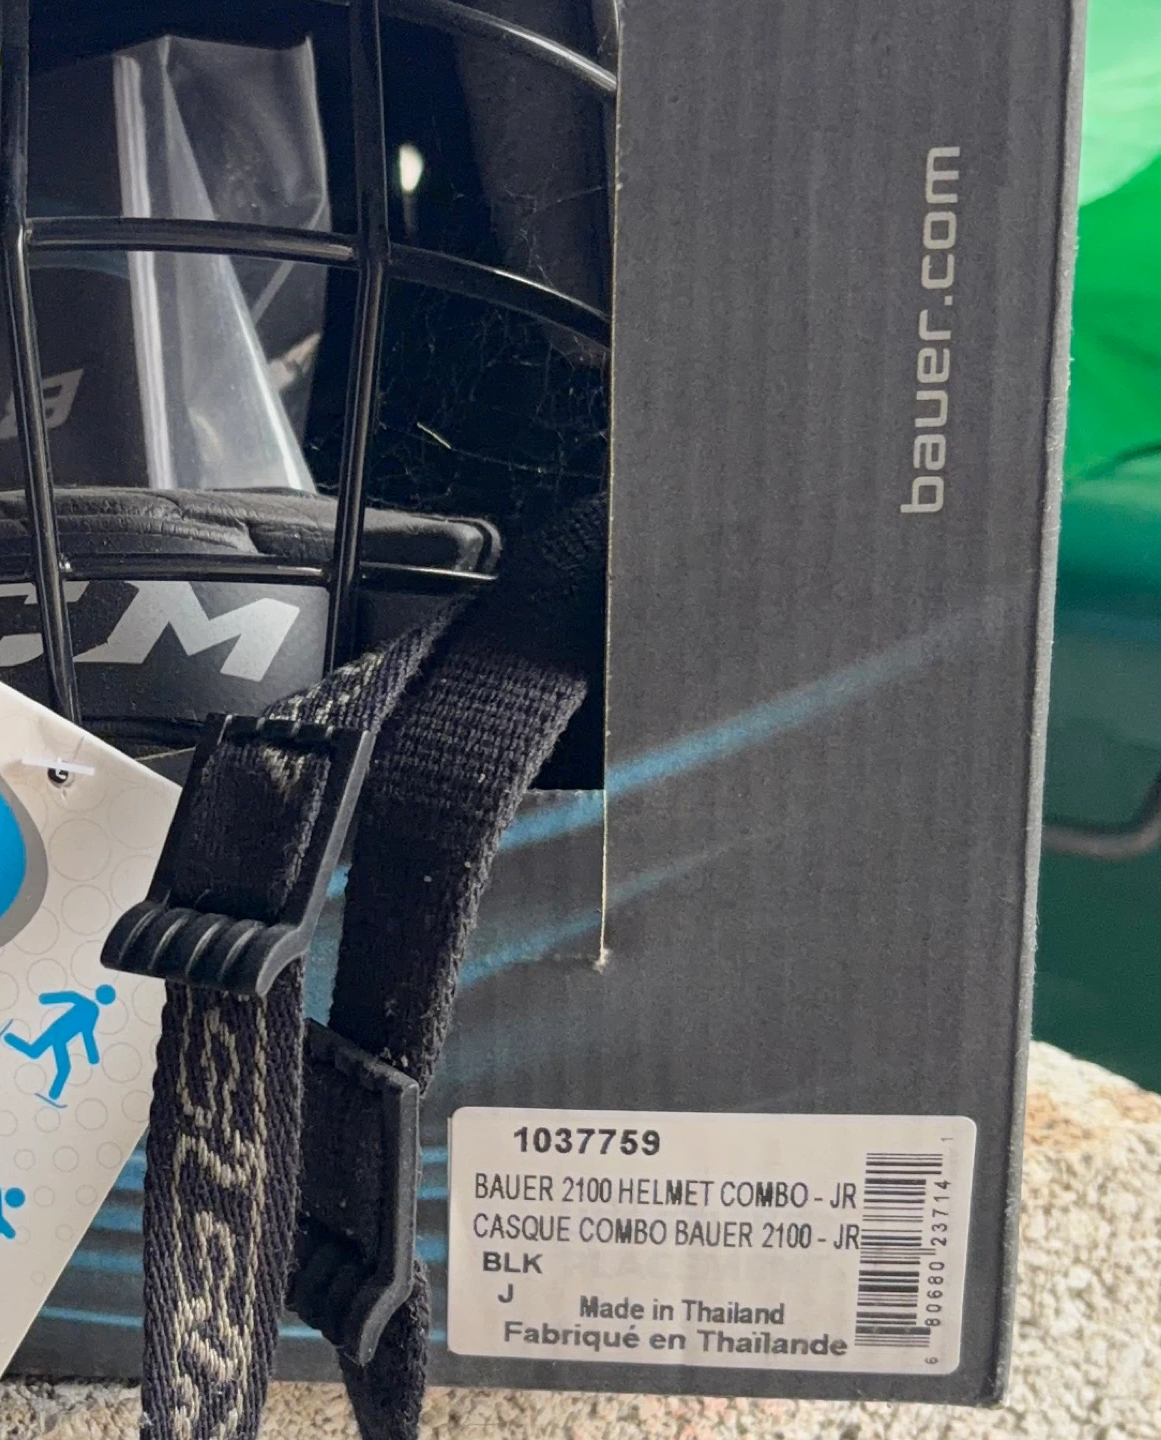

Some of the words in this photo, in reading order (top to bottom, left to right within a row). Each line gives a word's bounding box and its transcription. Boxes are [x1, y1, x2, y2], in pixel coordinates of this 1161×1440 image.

[900, 146, 961, 513] bauer.com
[513, 1126, 661, 1156] 1037759
[474, 1172, 554, 1202] BAUER
[561, 1175, 613, 1203] 2100
[618, 1177, 715, 1206] HELMET
[720, 1180, 809, 1209] COMBO
[829, 1182, 857, 1209] JR
[930, 1179, 952, 1247] 23714
[473, 1212, 572, 1244] CASQUE
[578, 1216, 668, 1247] COMBO
[674, 1219, 753, 1248] BAUER
[761, 1221, 813, 1249] 2100
[833, 1223, 860, 1250] JR
[482, 1250, 543, 1274] BLK
[497, 1283, 514, 1304] J
[579, 1295, 645, 1320] Made
[652, 1298, 674, 1321] in
[681, 1299, 785, 1325] Thailand
[924, 1261, 945, 1327] 80680
[503, 1320, 640, 1352] Fabriqué
[649, 1332, 686, 1350] en
